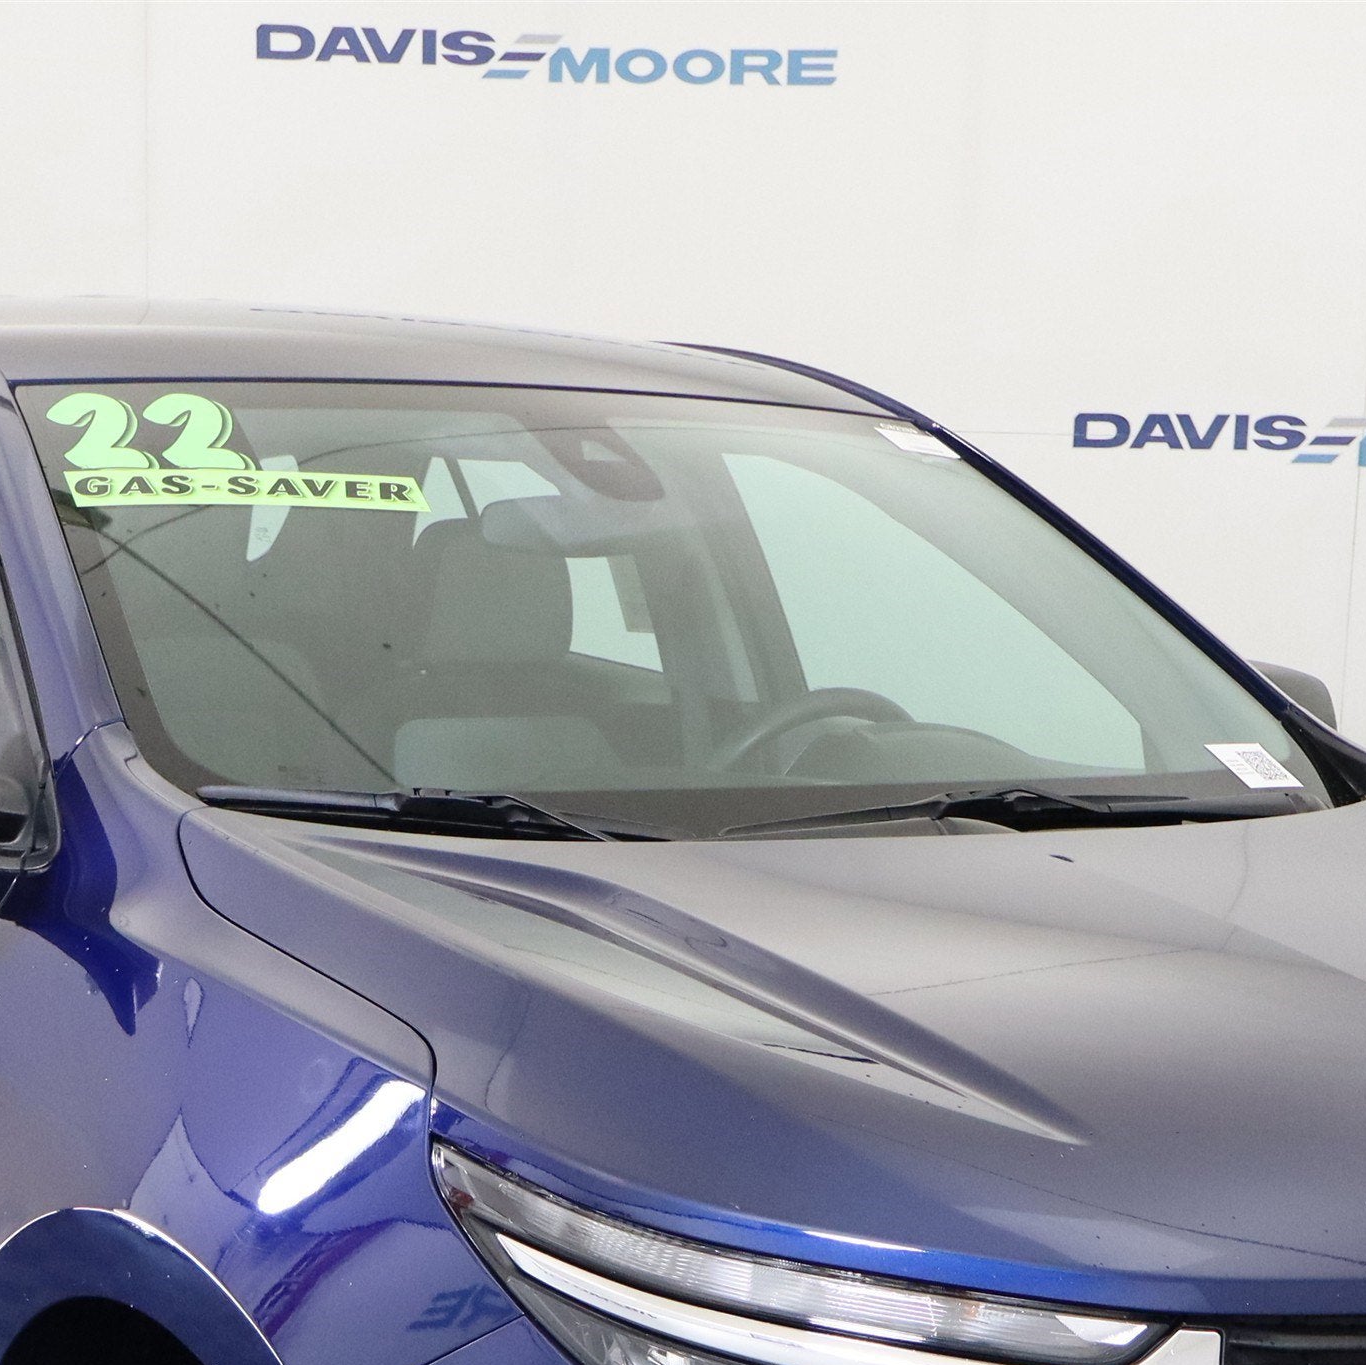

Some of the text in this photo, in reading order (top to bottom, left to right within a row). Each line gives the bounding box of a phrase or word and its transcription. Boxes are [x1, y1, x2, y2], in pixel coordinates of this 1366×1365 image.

[256, 23, 839, 87] DAVIS MOORE
[46, 392, 256, 471] 22
[1072, 412, 1308, 450] DAVIS
[73, 474, 415, 504] GAS-SAVER
